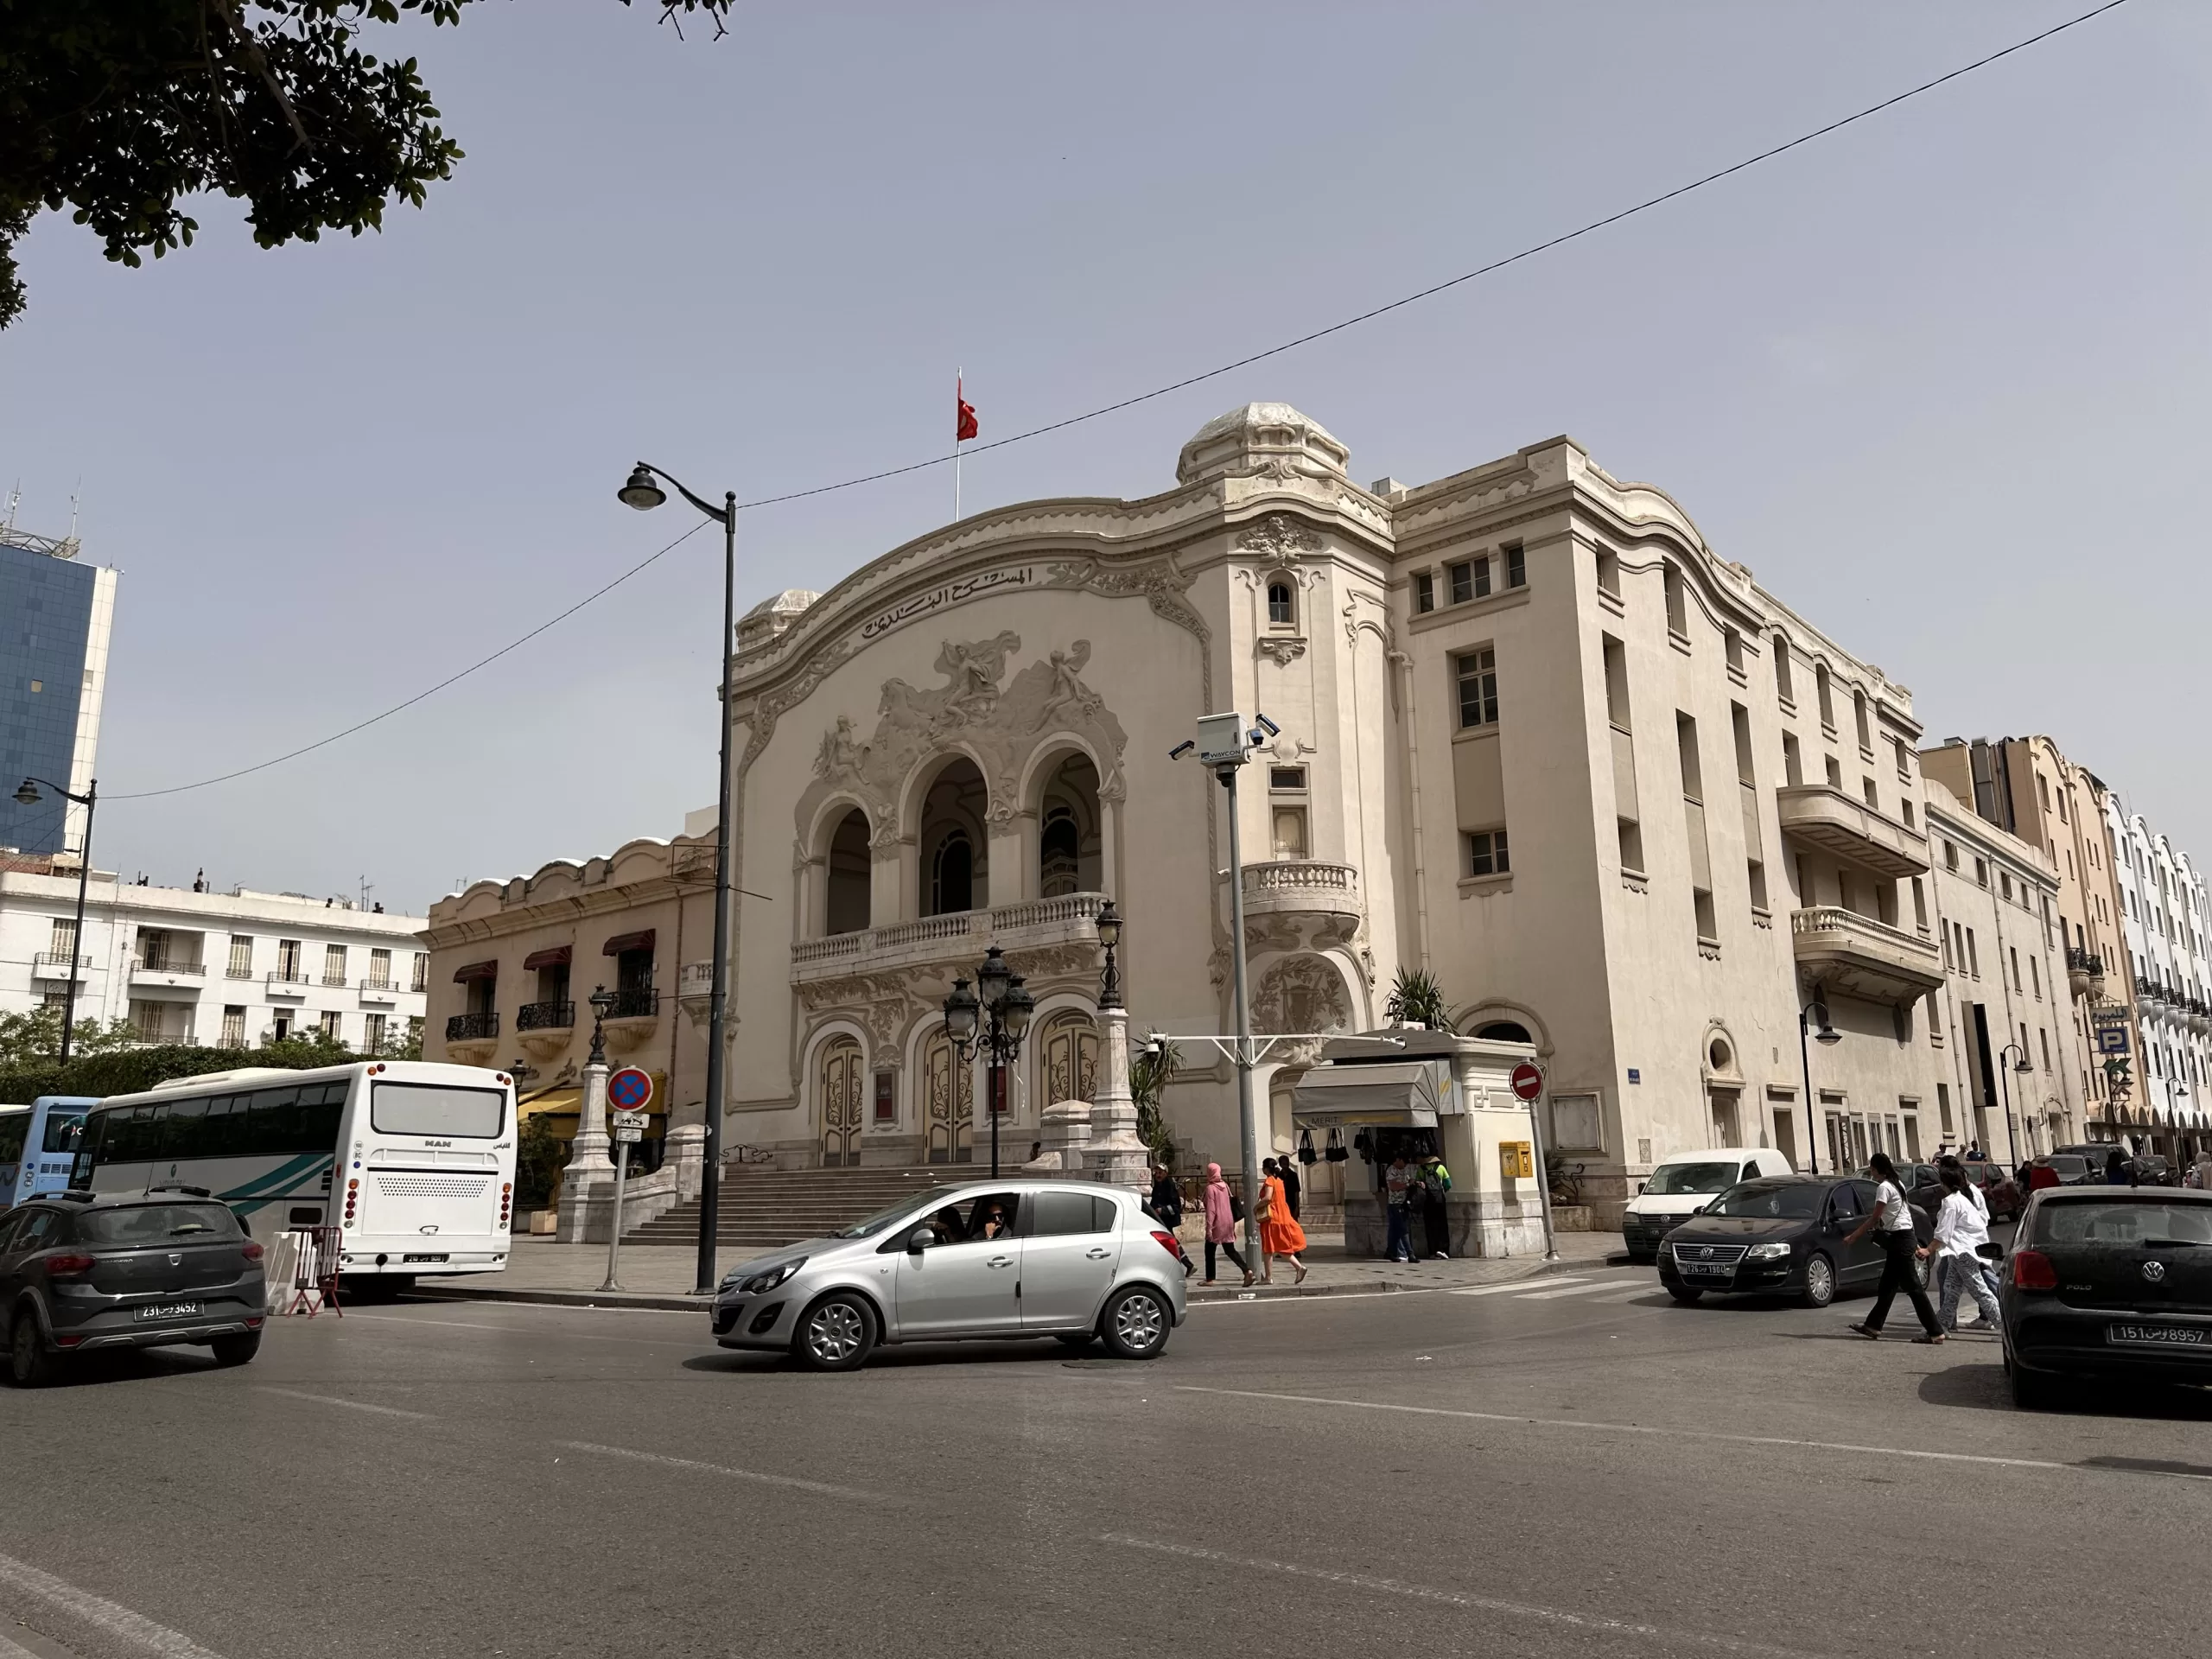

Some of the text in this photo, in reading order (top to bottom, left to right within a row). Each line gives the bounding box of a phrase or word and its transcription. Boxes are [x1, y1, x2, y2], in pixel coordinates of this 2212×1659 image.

[2102, 1032, 2123, 1049] P
[1688, 1264, 1699, 1273] 126
[143, 1306, 159, 1317] 231
[175, 1302, 197, 1313] 3452
[2120, 1326, 2145, 1338] 151
[2169, 1329, 2203, 1342] 8957
